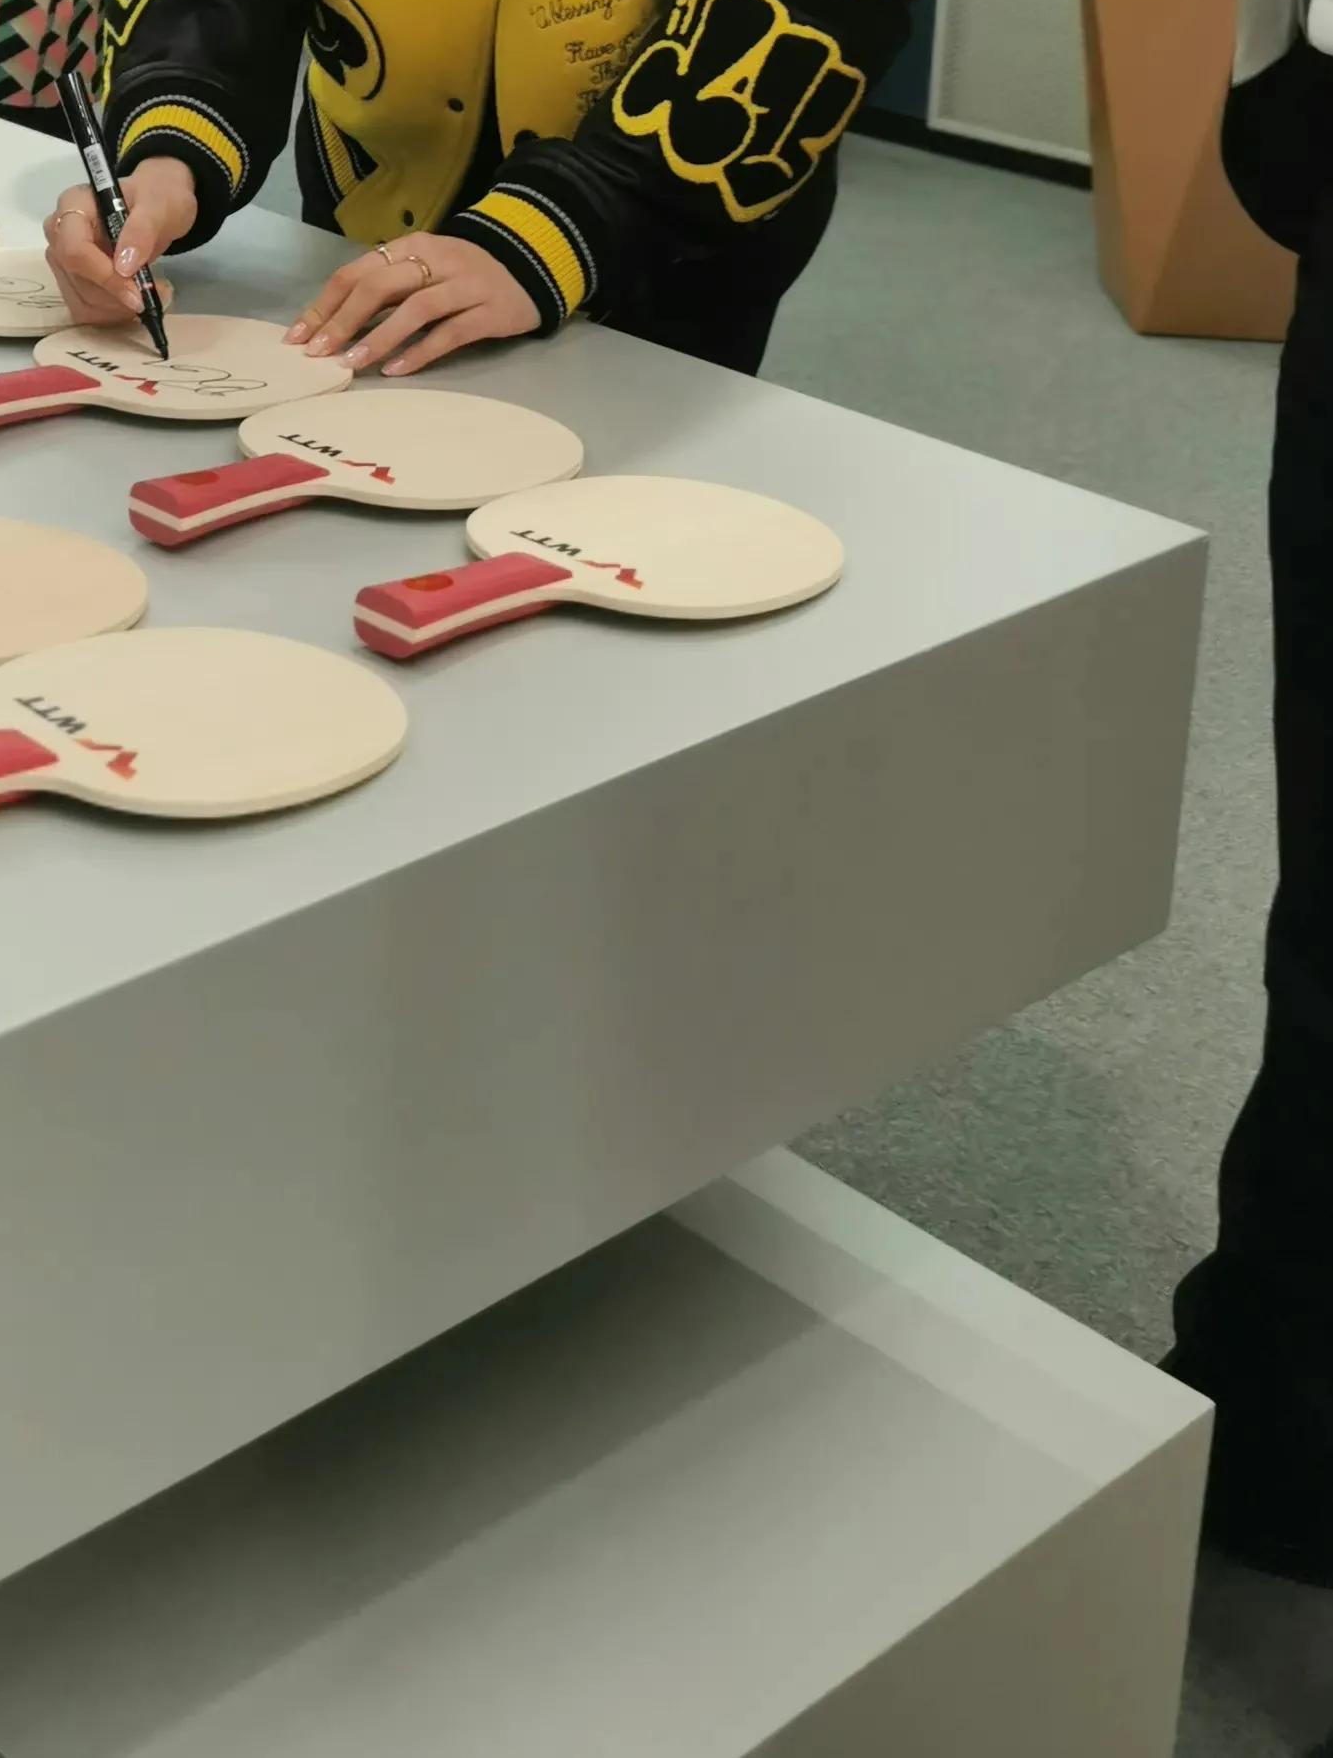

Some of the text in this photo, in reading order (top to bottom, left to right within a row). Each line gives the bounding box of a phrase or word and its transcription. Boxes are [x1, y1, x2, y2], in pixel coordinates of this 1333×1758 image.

[65, 351, 120, 372] WTT
[276, 433, 343, 457] WTT
[509, 530, 582, 556] WTT
[12, 696, 87, 734] WTT
